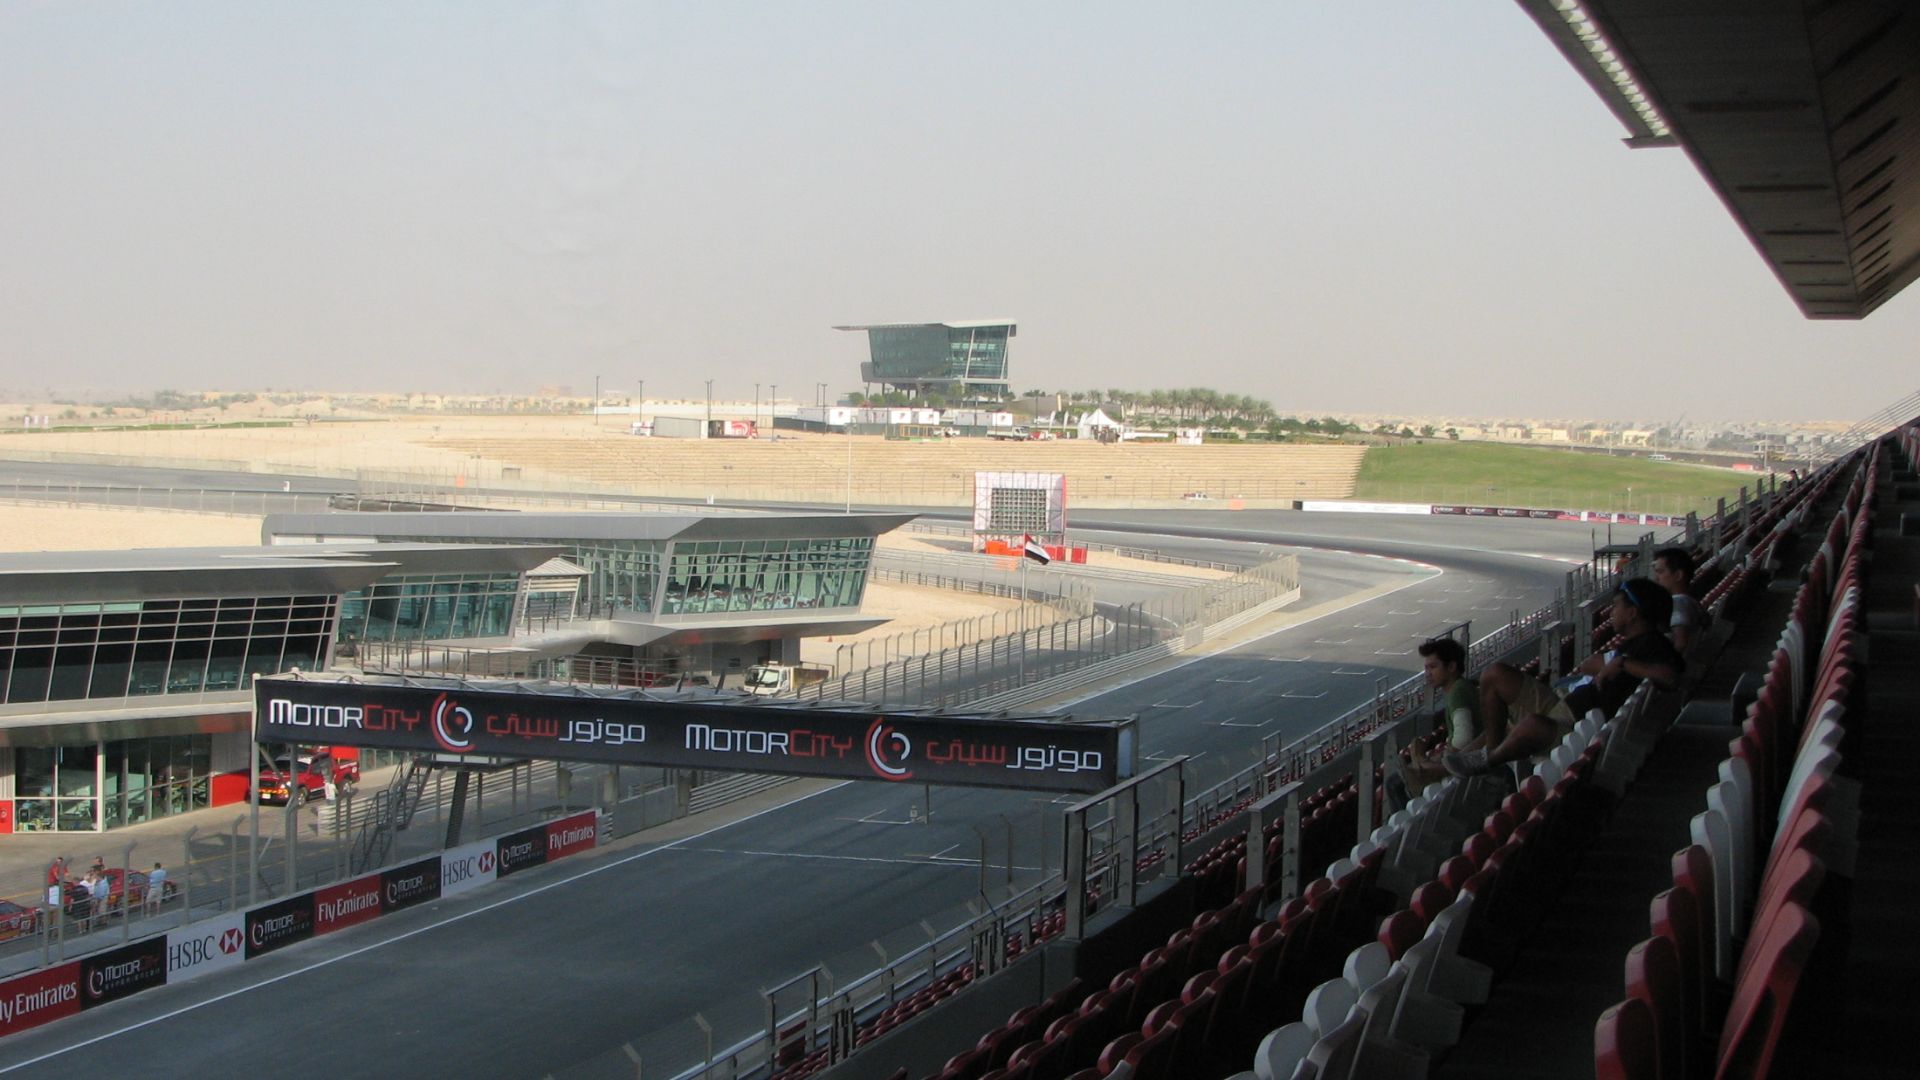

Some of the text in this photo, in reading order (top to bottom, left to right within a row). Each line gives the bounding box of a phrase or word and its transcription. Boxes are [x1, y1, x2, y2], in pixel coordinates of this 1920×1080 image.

[549, 825, 595, 850] Fly Emirates
[442, 856, 476, 887] HSBC
[318, 902, 335, 923] Fly
[337, 890, 380, 914] Emirates
[168, 935, 216, 972] HSBC
[16, 982, 77, 1016] Emirates
